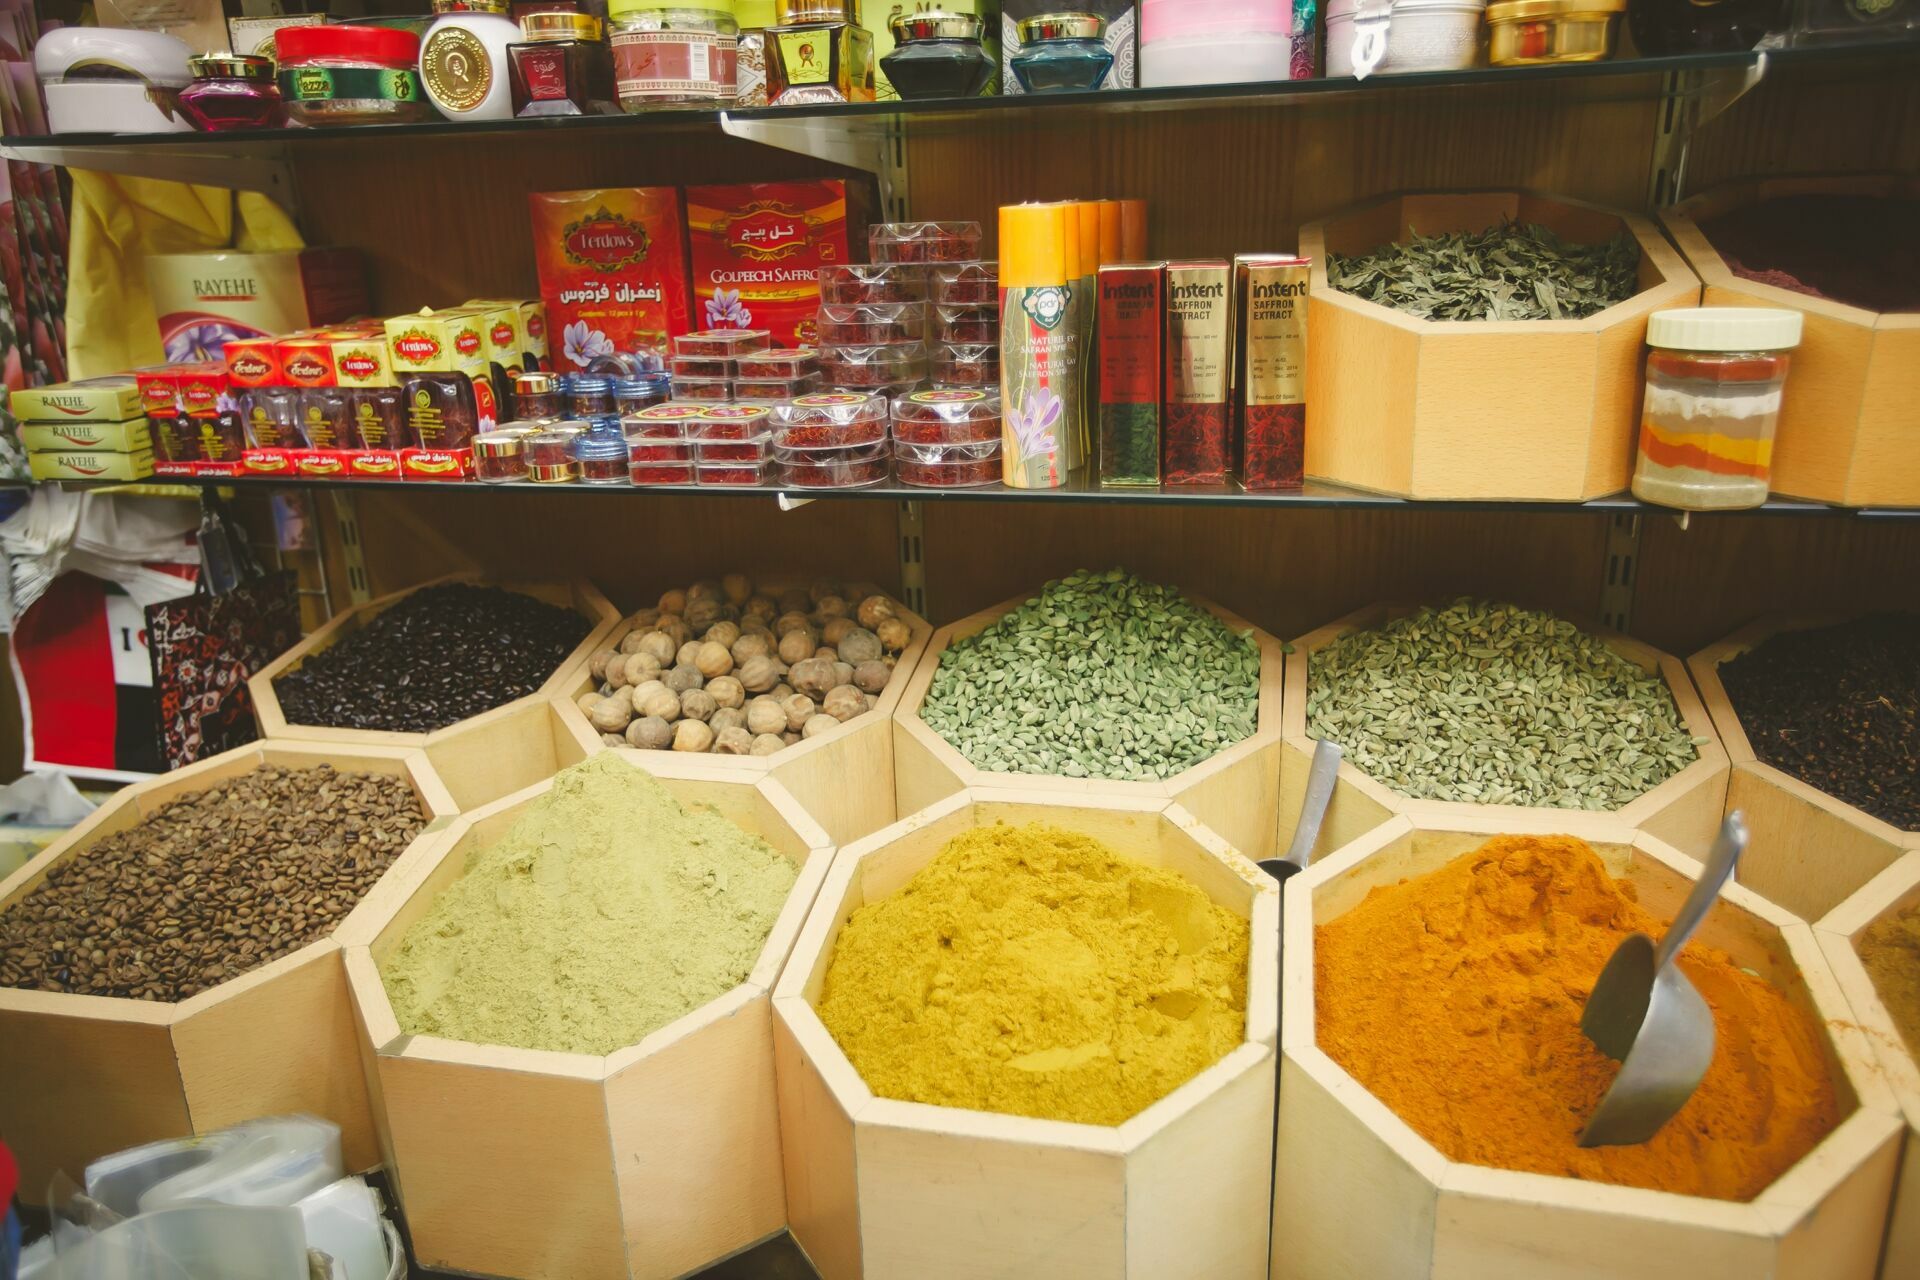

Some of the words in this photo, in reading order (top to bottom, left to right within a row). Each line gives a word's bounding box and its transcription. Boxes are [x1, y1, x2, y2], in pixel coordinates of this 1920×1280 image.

[710, 269, 773, 283] GOLPEECH
[775, 267, 820, 282] SAFFRO
[192, 279, 257, 295] RAYEHE
[560, 283, 610, 304] فردوس
[615, 282, 662, 303] زعفران
[1171, 280, 1224, 298] instent
[1253, 280, 1306, 298] instent
[1171, 301, 1212, 309] SAFFRON
[1253, 300, 1294, 310] SAFFRON
[1253, 310, 1293, 320] EXTRACT
[42, 396, 85, 407] RAYEHE
[52, 427, 94, 437] RAYEHE
[58, 457, 97, 466] RAYEHE
